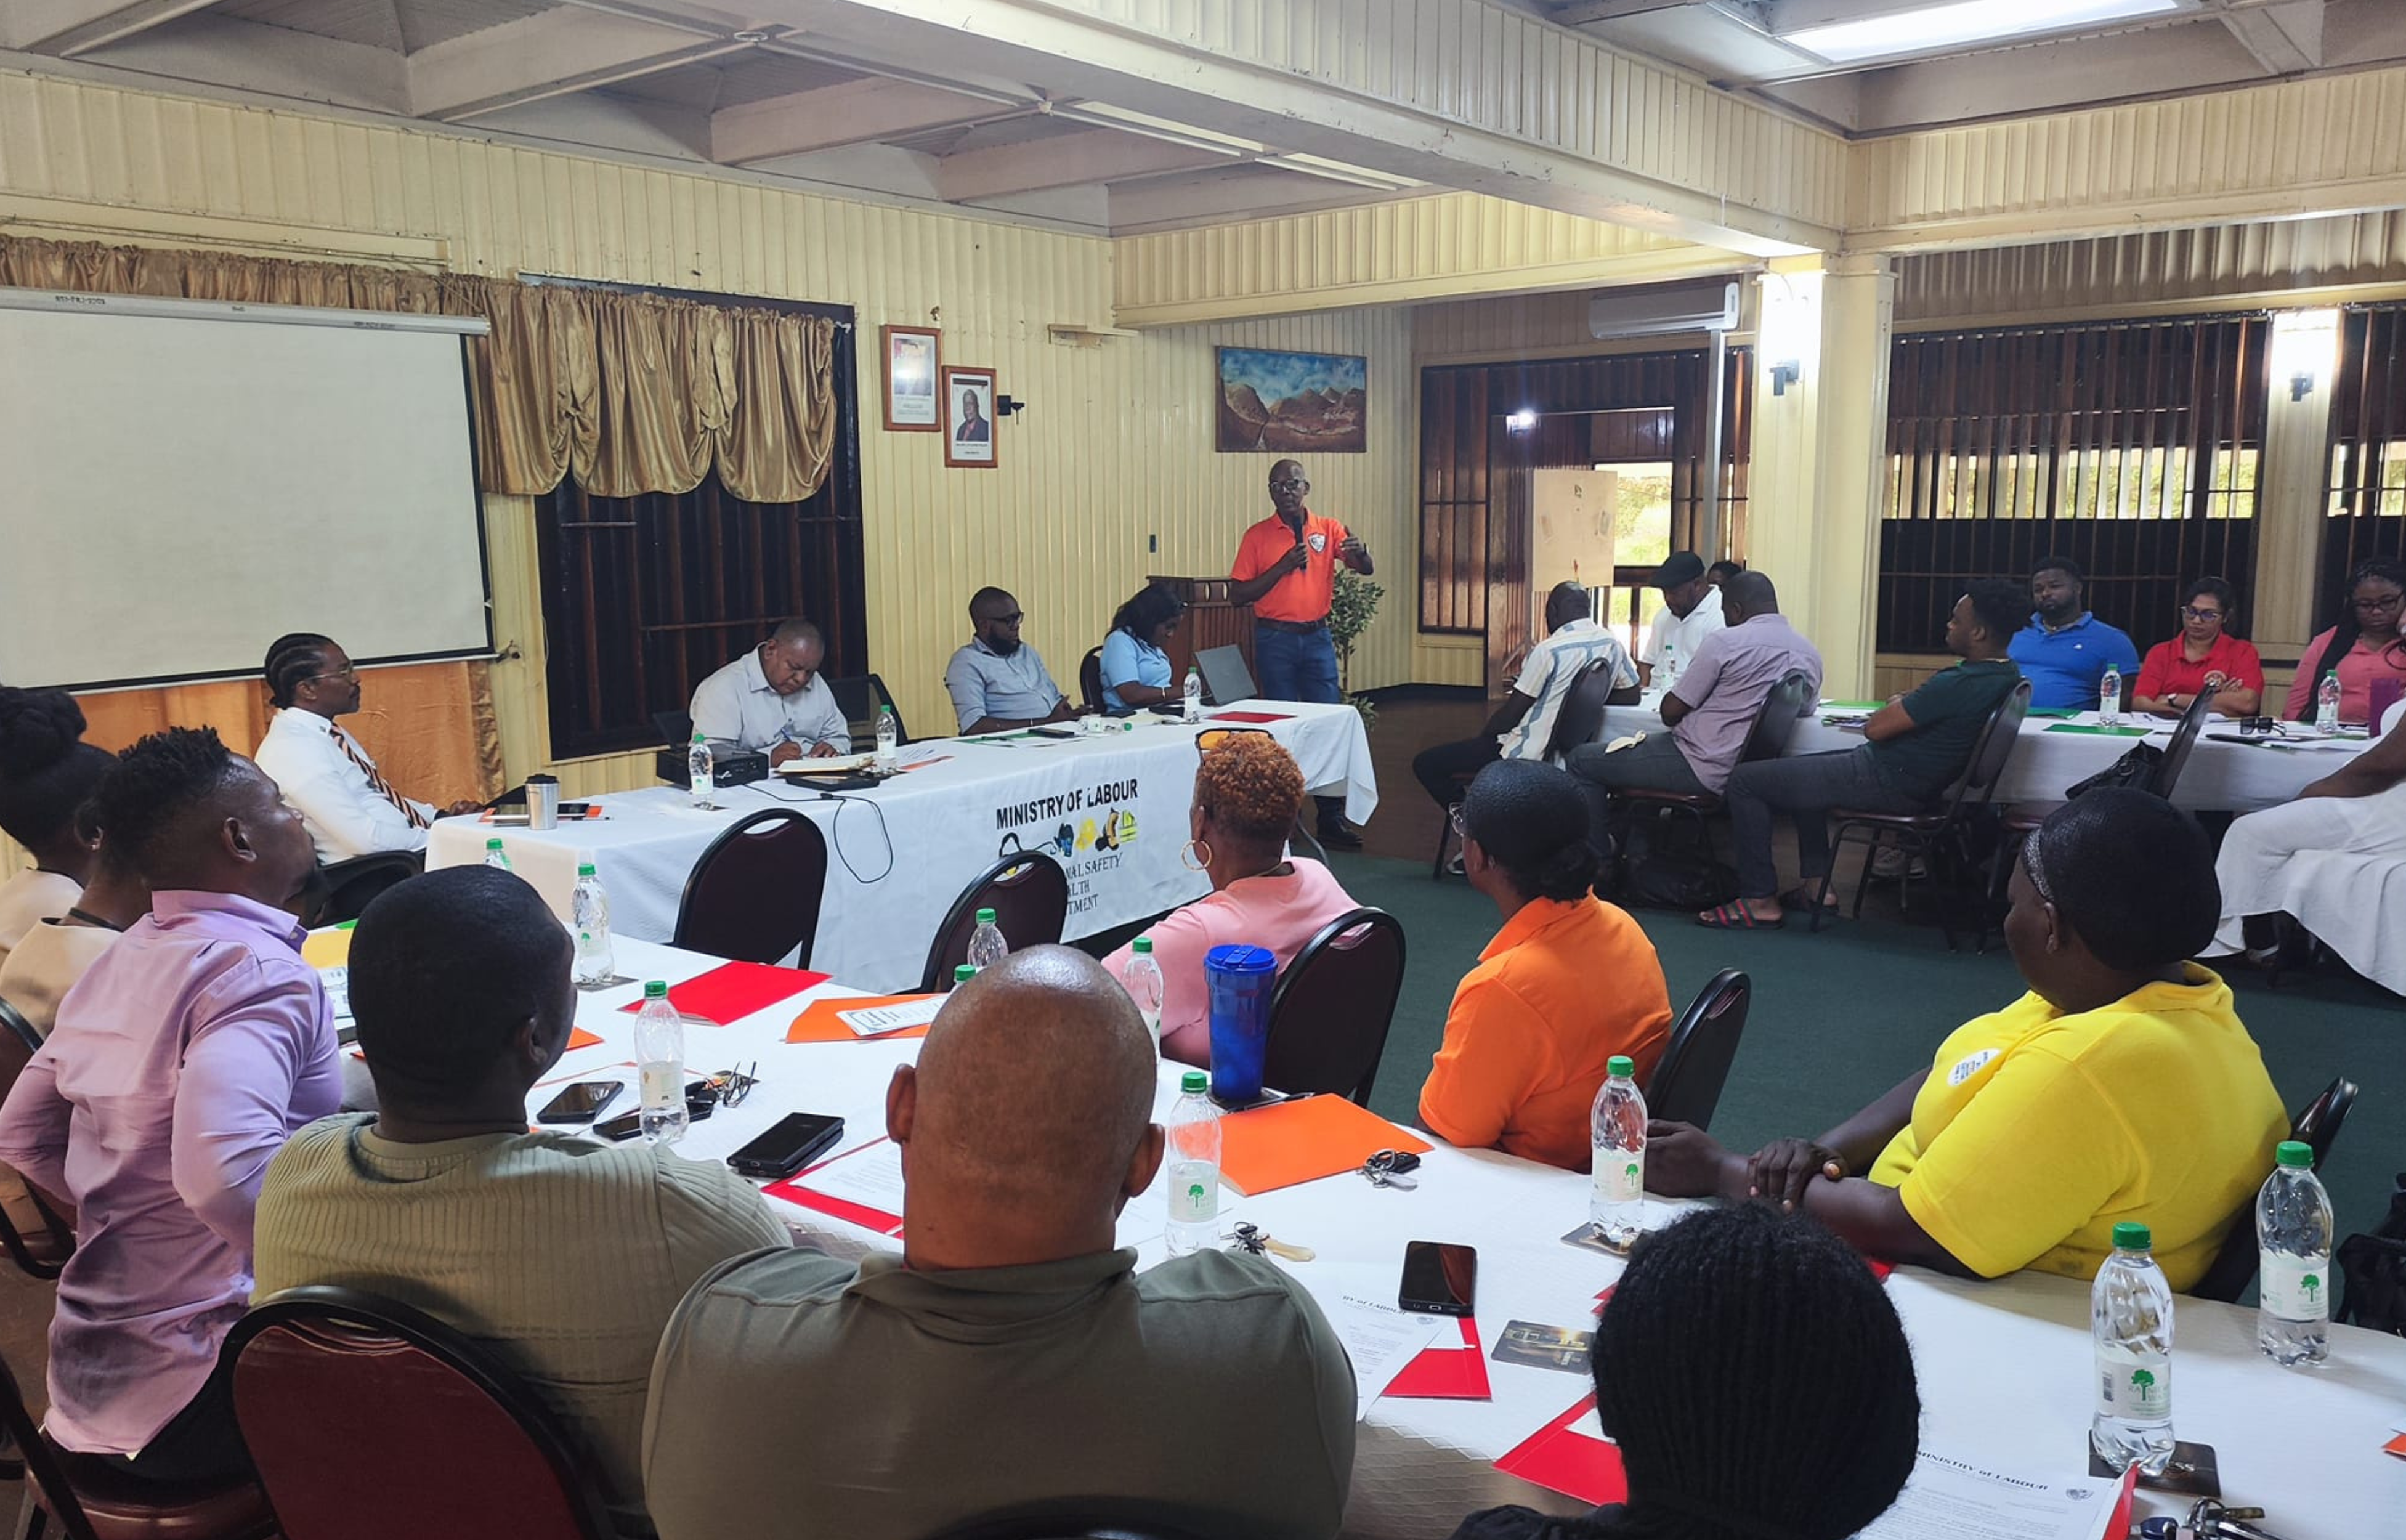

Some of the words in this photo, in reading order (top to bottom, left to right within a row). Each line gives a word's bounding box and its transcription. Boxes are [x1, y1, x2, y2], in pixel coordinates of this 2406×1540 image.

[996, 795, 1065, 829] MINISTRY
[1067, 789, 1083, 813] OF
[1087, 779, 1138, 808] LABOUR
[1066, 864, 1084, 880] NAL
[1085, 851, 1123, 875] SAFETY
[1067, 879, 1090, 898] ALTH
[1067, 894, 1099, 915] TMENT
